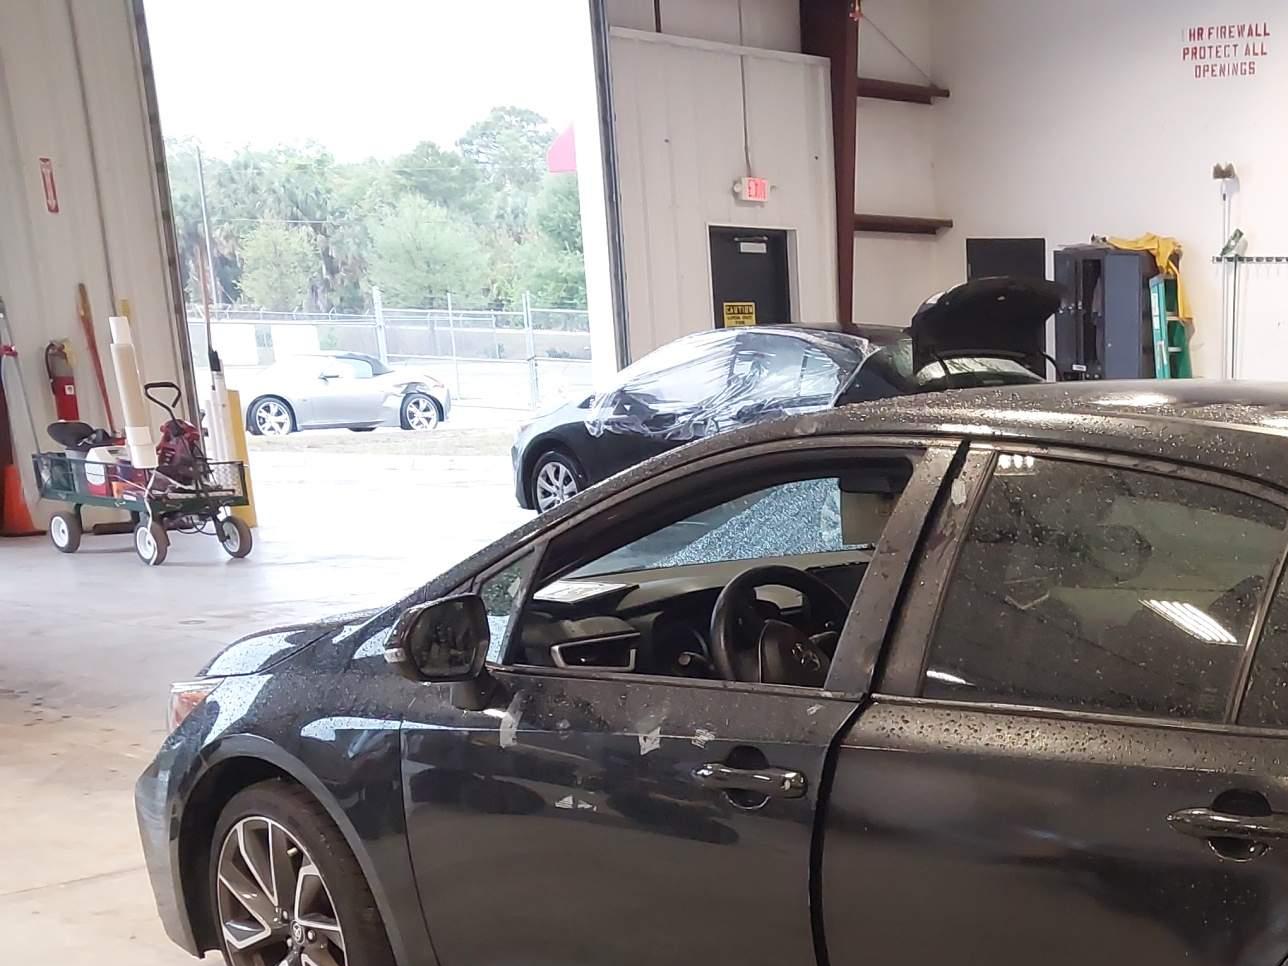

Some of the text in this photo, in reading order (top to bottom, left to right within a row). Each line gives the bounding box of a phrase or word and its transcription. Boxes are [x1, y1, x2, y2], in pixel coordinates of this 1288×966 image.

[1188, 27, 1204, 42] HR
[1207, 22, 1271, 40] FIREWALL
[1182, 42, 1268, 61] PROTECT ALL
[1194, 61, 1256, 78] OPENINGS
